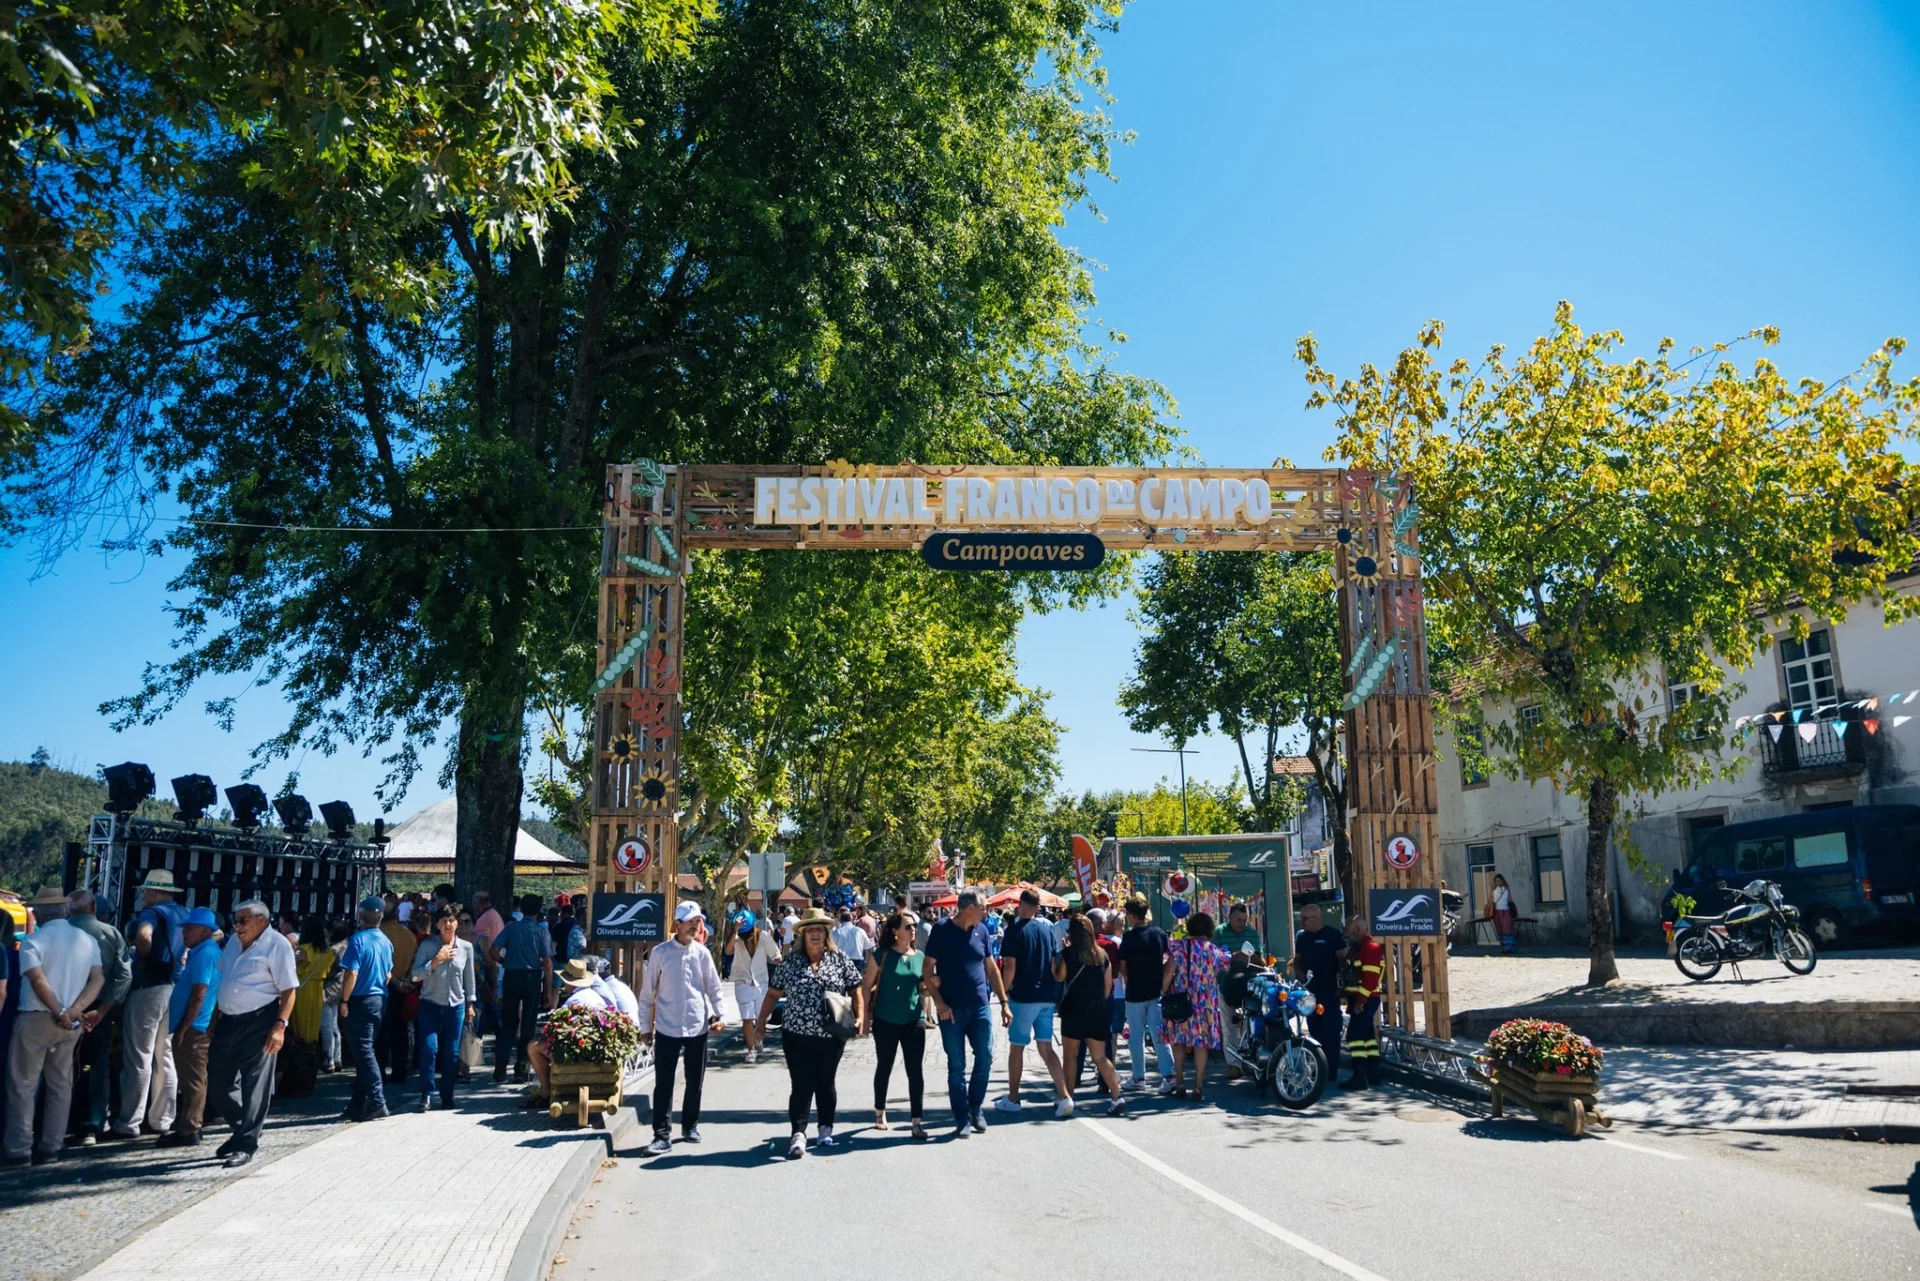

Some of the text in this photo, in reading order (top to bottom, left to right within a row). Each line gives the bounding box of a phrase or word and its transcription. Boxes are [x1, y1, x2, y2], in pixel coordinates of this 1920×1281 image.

[755, 477, 1272, 522] FESTIVAL FRANGO DO CAMPO
[942, 538, 1085, 567] Campoaves
[596, 927, 625, 936] Oliveira
[632, 927, 656, 936] Frades
[1376, 923, 1403, 931] Oliveira
[1410, 923, 1433, 931] Frades
